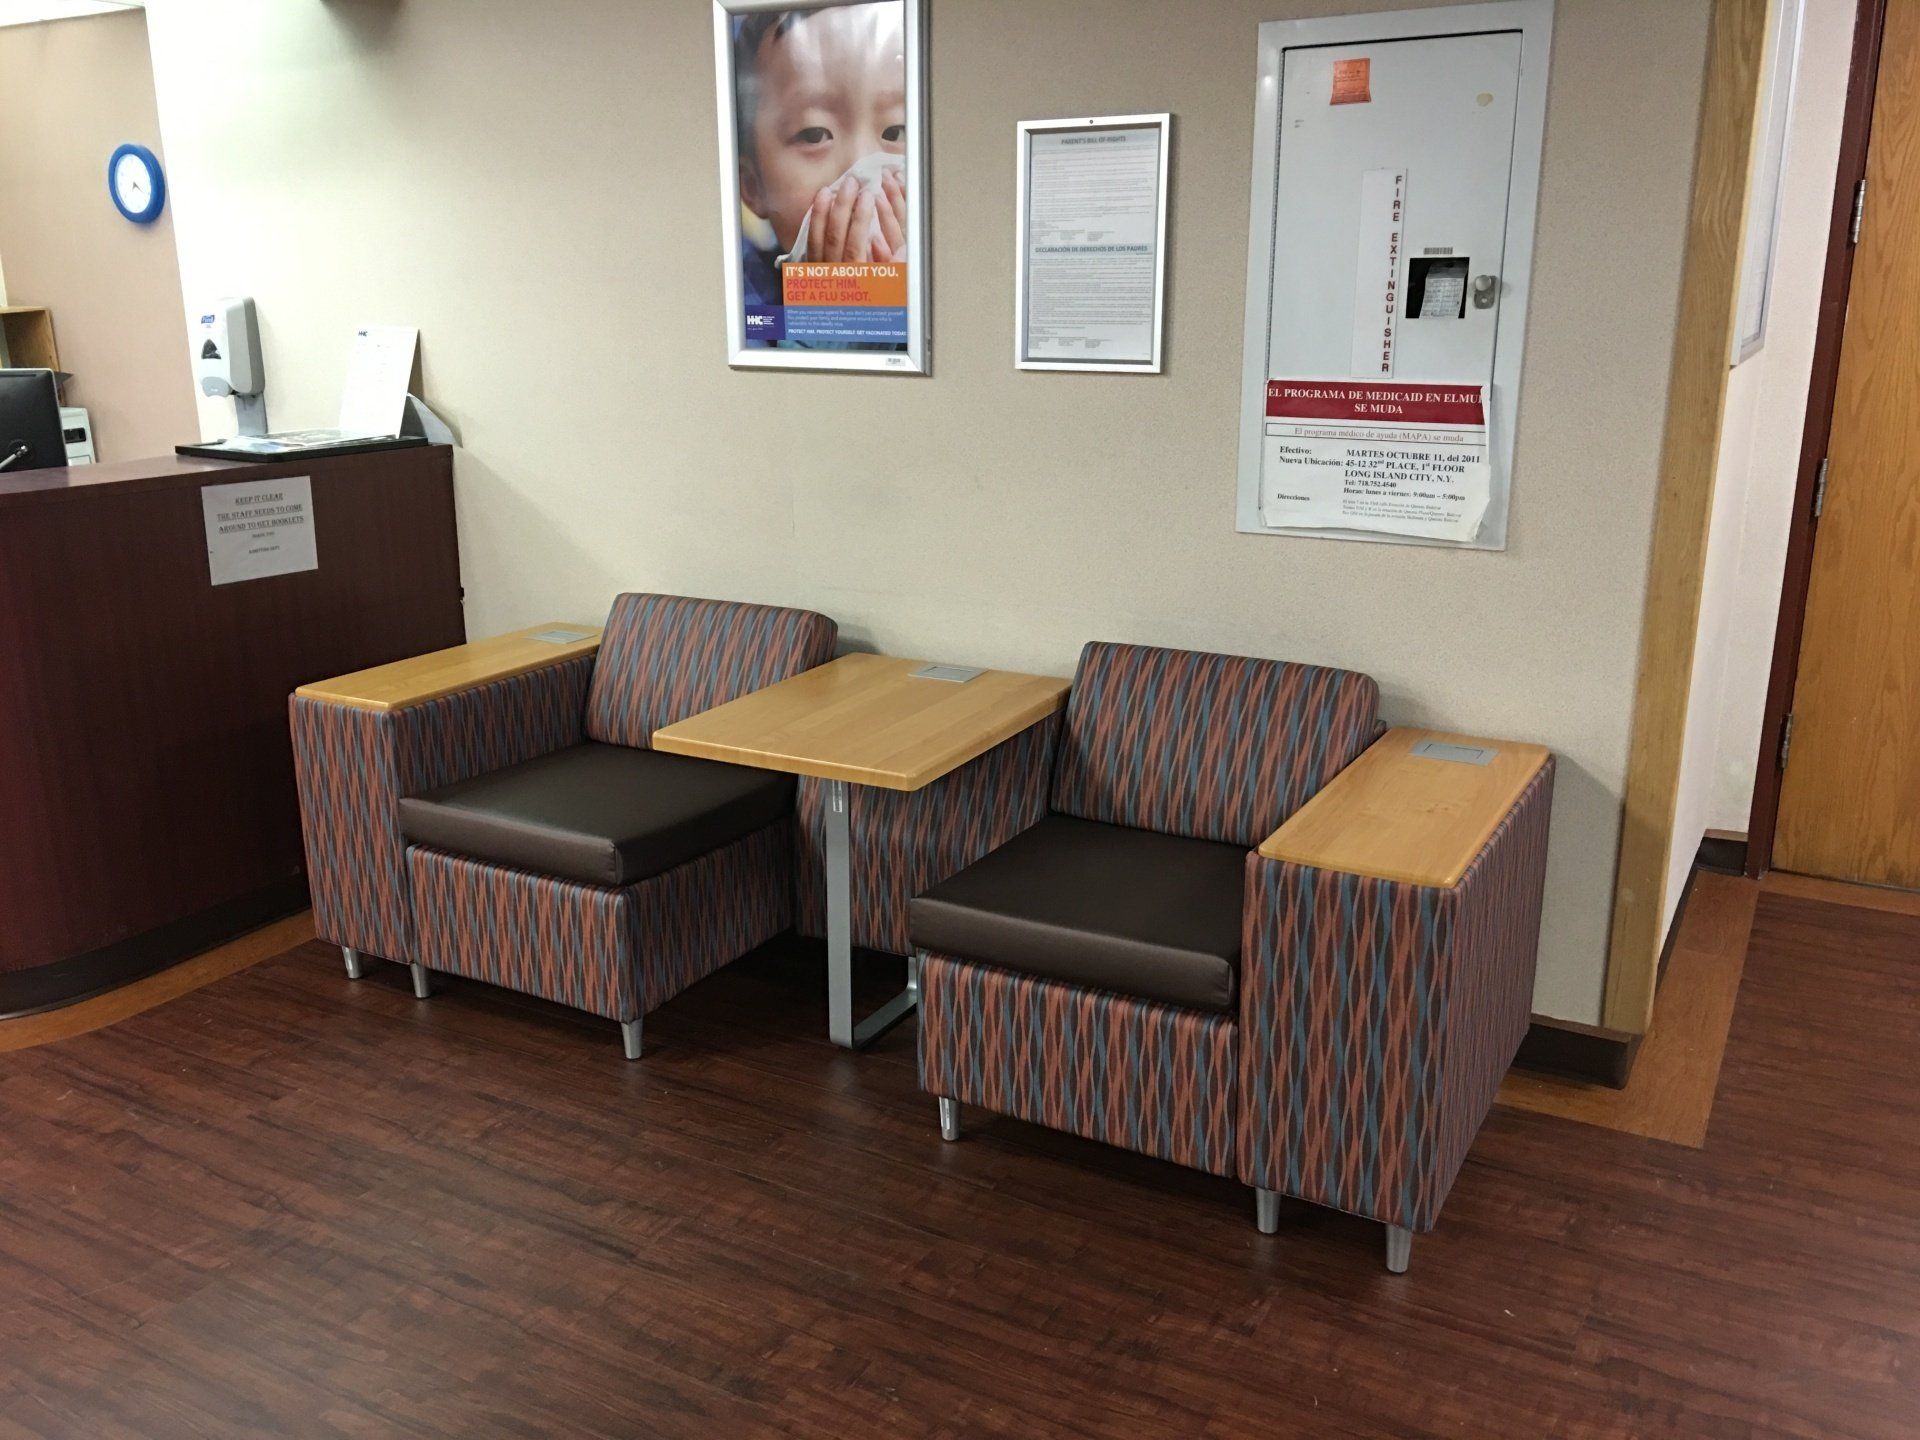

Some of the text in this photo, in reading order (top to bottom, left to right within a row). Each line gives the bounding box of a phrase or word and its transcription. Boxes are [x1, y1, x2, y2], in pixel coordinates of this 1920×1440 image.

[1392, 176, 1402, 222] FIRE
[786, 266, 899, 277] IT'S NOT ABOUT YOU.
[786, 279, 860, 289] PROTECT HIM.
[787, 291, 871, 302] GET A FLU SHOT.
[1382, 232, 1398, 372] EXTINGUISHER
[1268, 388, 1281, 397] EL
[1284, 389, 1346, 399] PROGRAMA
[1348, 391, 1363, 399] DE
[1366, 391, 1423, 402] MEDICAID
[1425, 393, 1441, 402] EN
[1354, 404, 1403, 414] SE MUDA
[1304, 429, 1336, 437] programa
[1338, 428, 1365, 437] médico
[1366, 430, 1375, 438] de
[1376, 432, 1397, 440] ayuda
[1399, 432, 1431, 441] (MAPA)
[1280, 446, 1312, 455] Efectivo:
[1346, 448, 1384, 458] MARTES
[1386, 451, 1431, 461] OCTUBRE
[1447, 454, 1460, 463] del
[1461, 455, 1480, 463] 2011
[1280, 456, 1343, 467] Nueva Ubicación:
[1345, 460, 1366, 468] 45-12
[1386, 462, 1419, 471] PLACE,
[1432, 464, 1465, 473] FLOOR
[1344, 470, 1371, 478] LONG
[1373, 471, 1407, 480] ISLAND
[1409, 473, 1435, 482] CITY,
[235, 493, 283, 505] KEEP IT CLEAR
[217, 504, 303, 521] THE STAFF NEEDS TO COME
[219, 524, 246, 534] AROUND
[257, 521, 271, 529] GET
[272, 516, 304, 527] BOOKLETS
